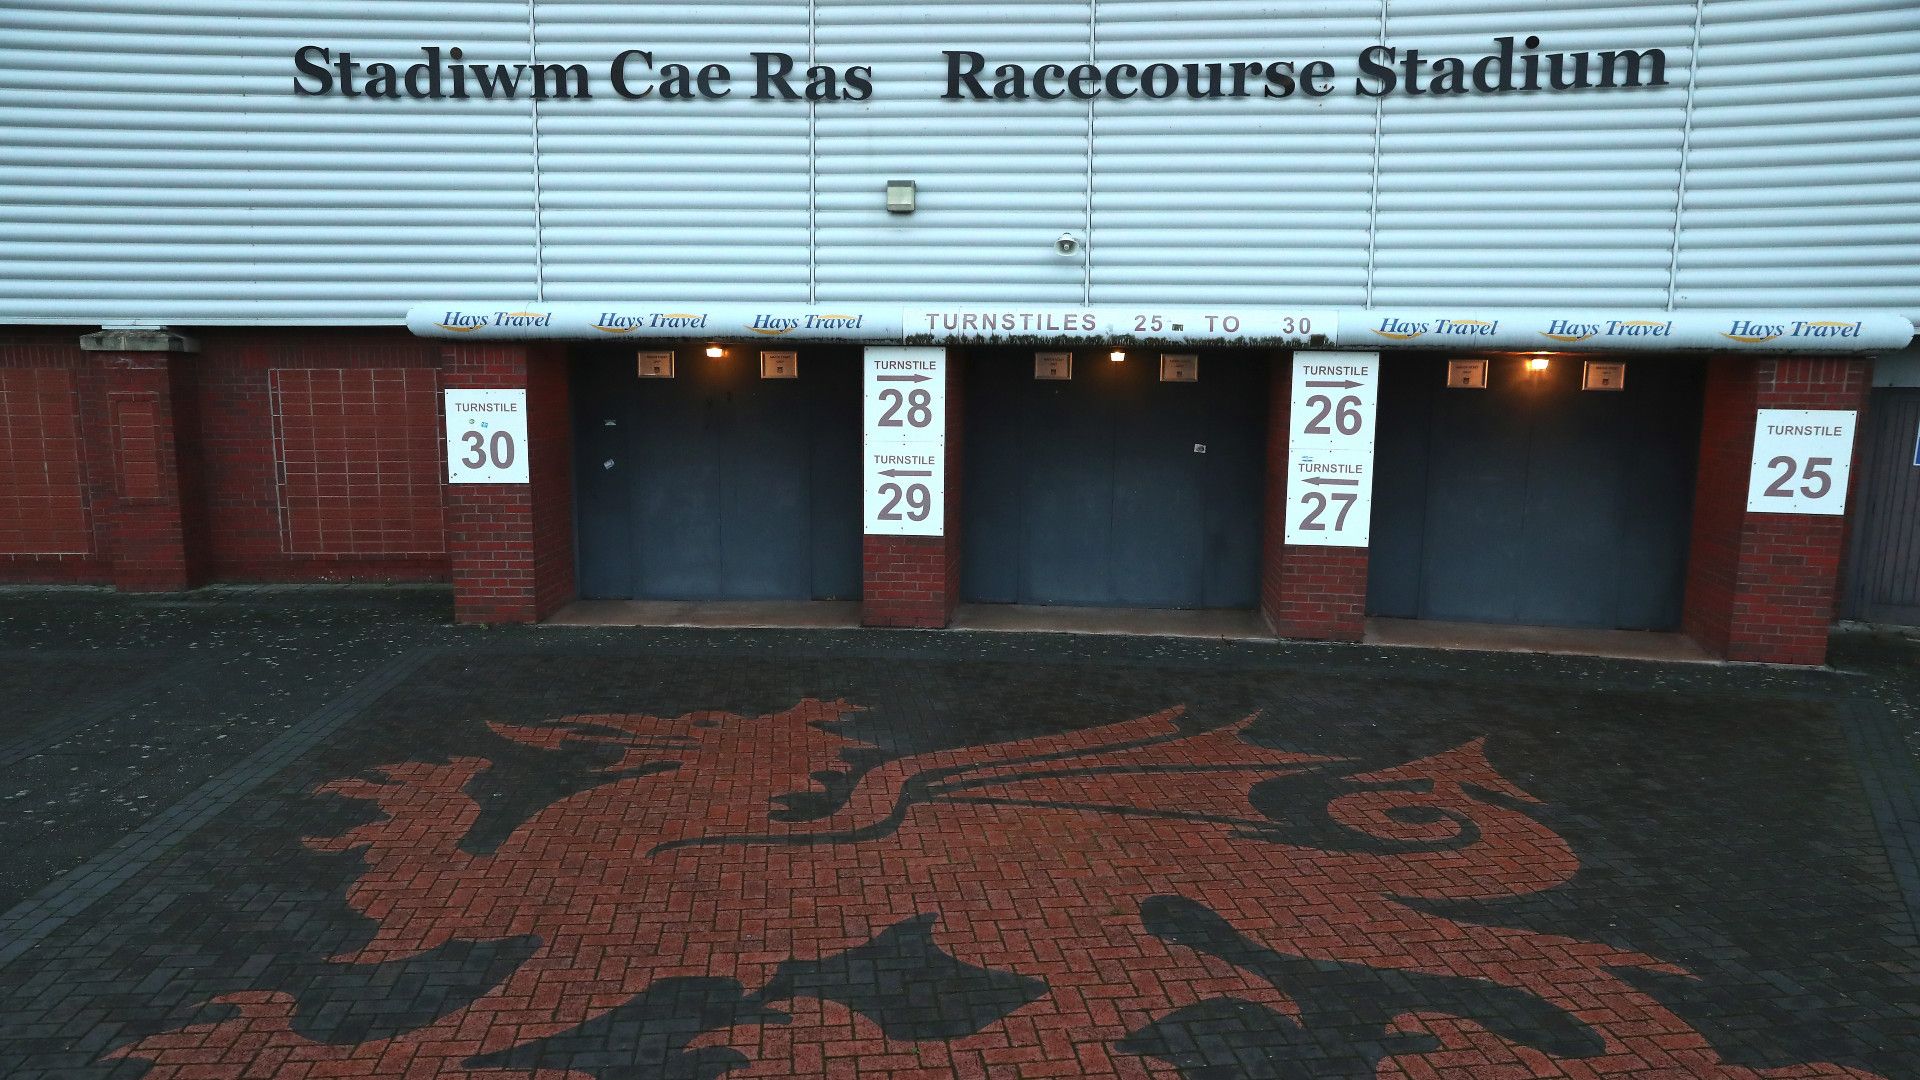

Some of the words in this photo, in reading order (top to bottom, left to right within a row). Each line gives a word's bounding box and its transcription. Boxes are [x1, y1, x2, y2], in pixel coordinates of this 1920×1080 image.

[293, 45, 593, 99] Stadiwm
[610, 49, 731, 100] Cae
[749, 51, 874, 101] Ras
[940, 49, 1336, 100] Racecourse
[1354, 34, 1670, 97] Stadium
[443, 311, 488, 330] Hays
[493, 311, 552, 327] Travel
[598, 312, 643, 331] Hays
[649, 313, 708, 329] Travel
[753, 314, 799, 333] Hays
[805, 314, 863, 329] Travel
[926, 313, 1097, 332] TURNSTILES
[1134, 314, 1164, 332] 25
[1204, 315, 1241, 333] TO
[1282, 316, 1312, 335] 30
[1380, 318, 1429, 337] Hays
[1435, 319, 1499, 336] Travel
[1547, 319, 1600, 339] Hays
[1606, 320, 1672, 337] Travel
[1729, 320, 1785, 340] Hays
[1791, 321, 1862, 338] Travel
[874, 359, 937, 371] TURNSTILE
[1303, 364, 1370, 377] TURNSTILE
[454, 402, 518, 413] TURNSTILE
[877, 388, 933, 429] 28
[1303, 394, 1364, 437] 26
[1767, 424, 1844, 437] TURNSTILE
[460, 430, 516, 471] 30
[874, 454, 936, 466] TURNSTILE
[1298, 463, 1363, 474] TURNSTILE
[1763, 455, 1833, 500] 25
[876, 482, 932, 523] 29
[1298, 490, 1359, 532] 27
